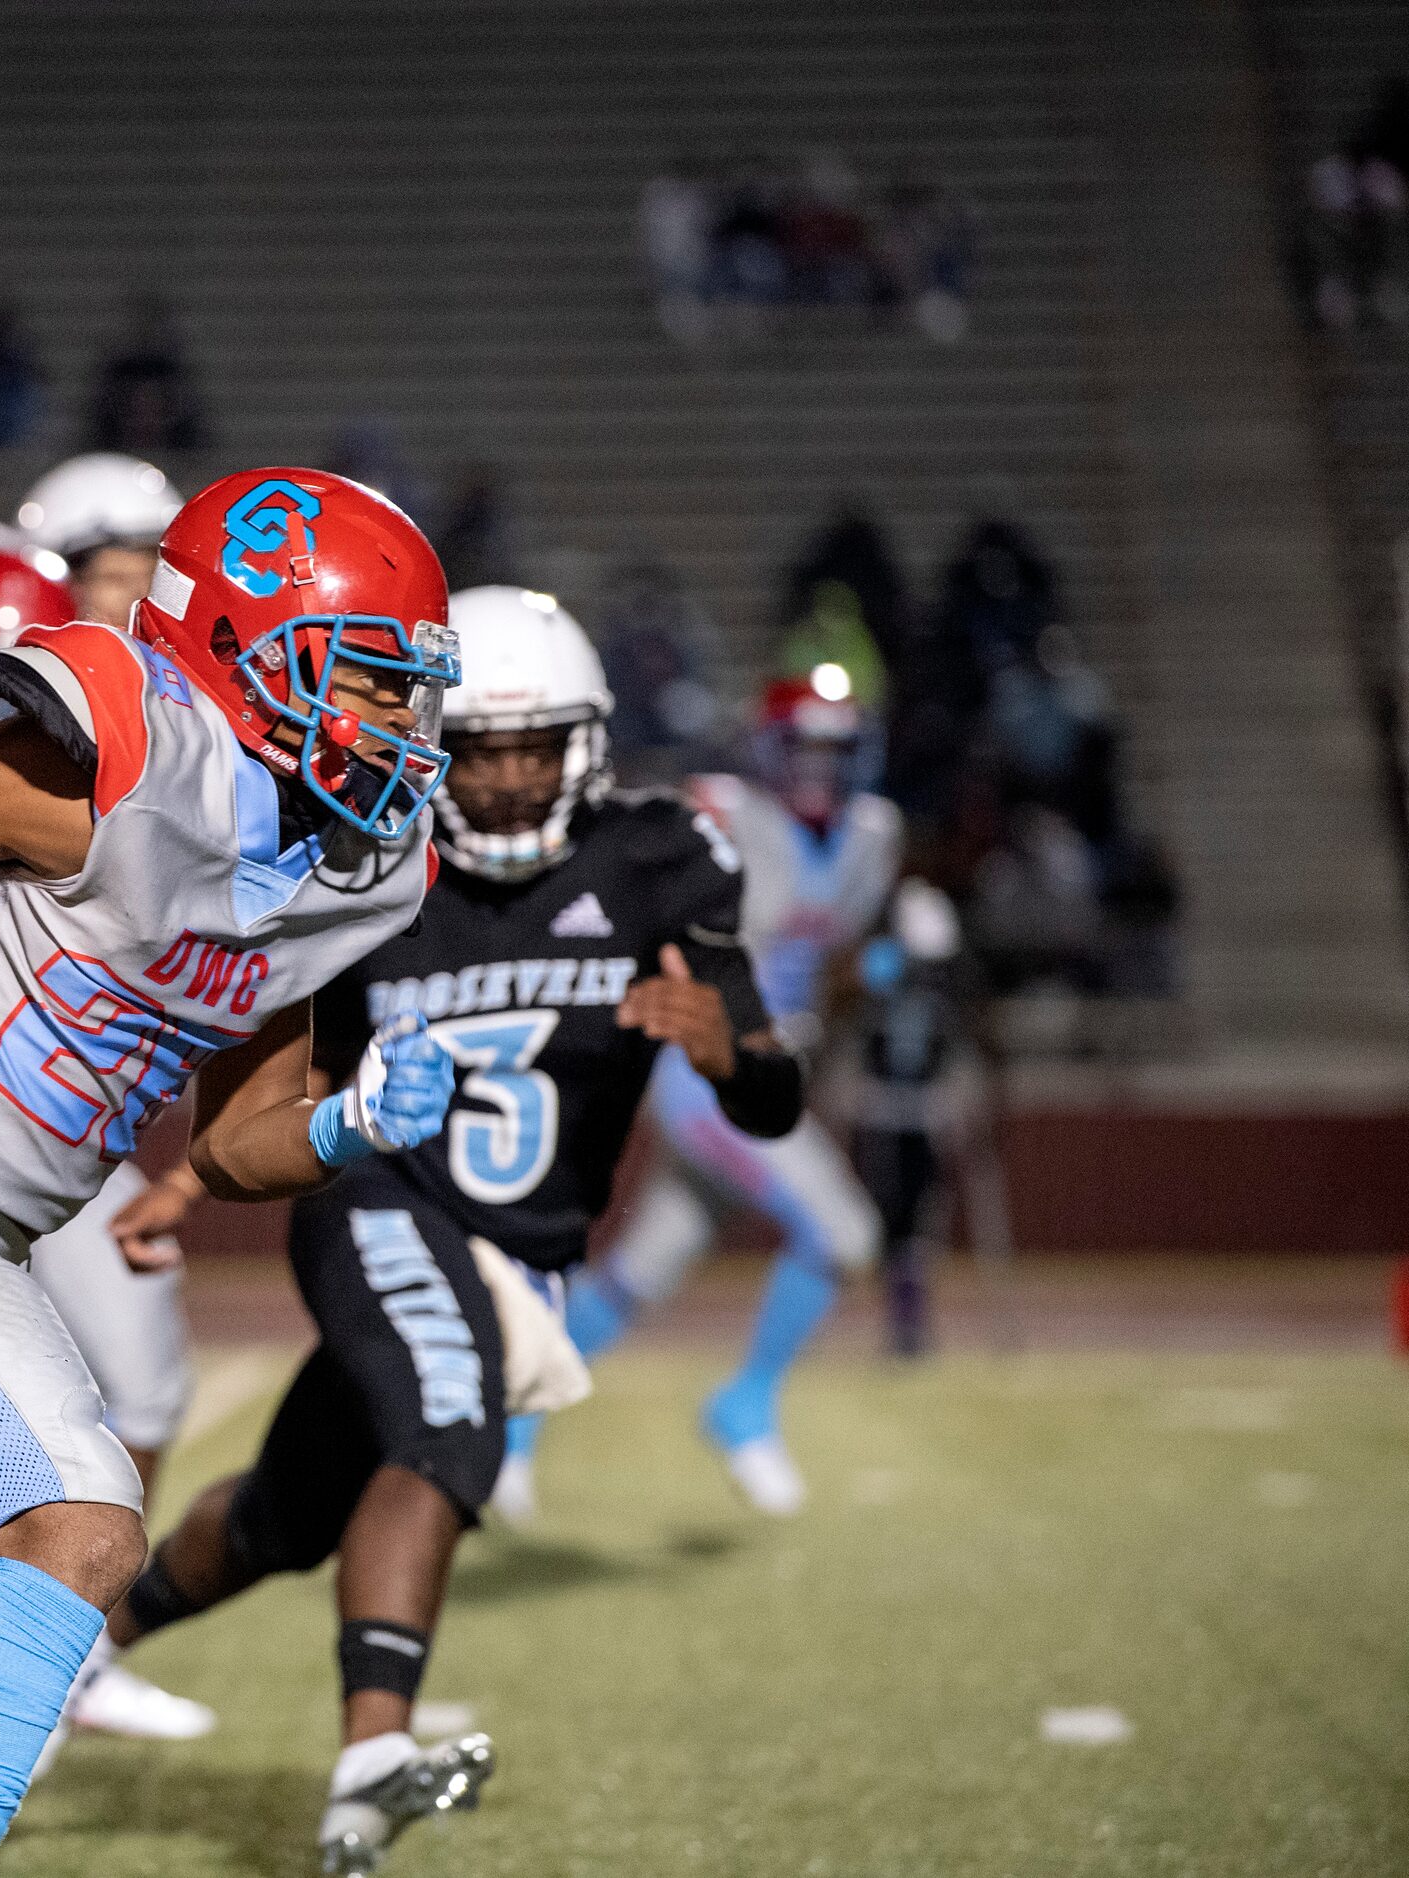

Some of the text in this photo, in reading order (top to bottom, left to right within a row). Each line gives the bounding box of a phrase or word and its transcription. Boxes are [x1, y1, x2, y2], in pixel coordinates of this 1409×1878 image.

[258, 744, 299, 771] DAMS
[142, 928, 271, 1016] DWC
[427, 1007, 560, 1205] 3
